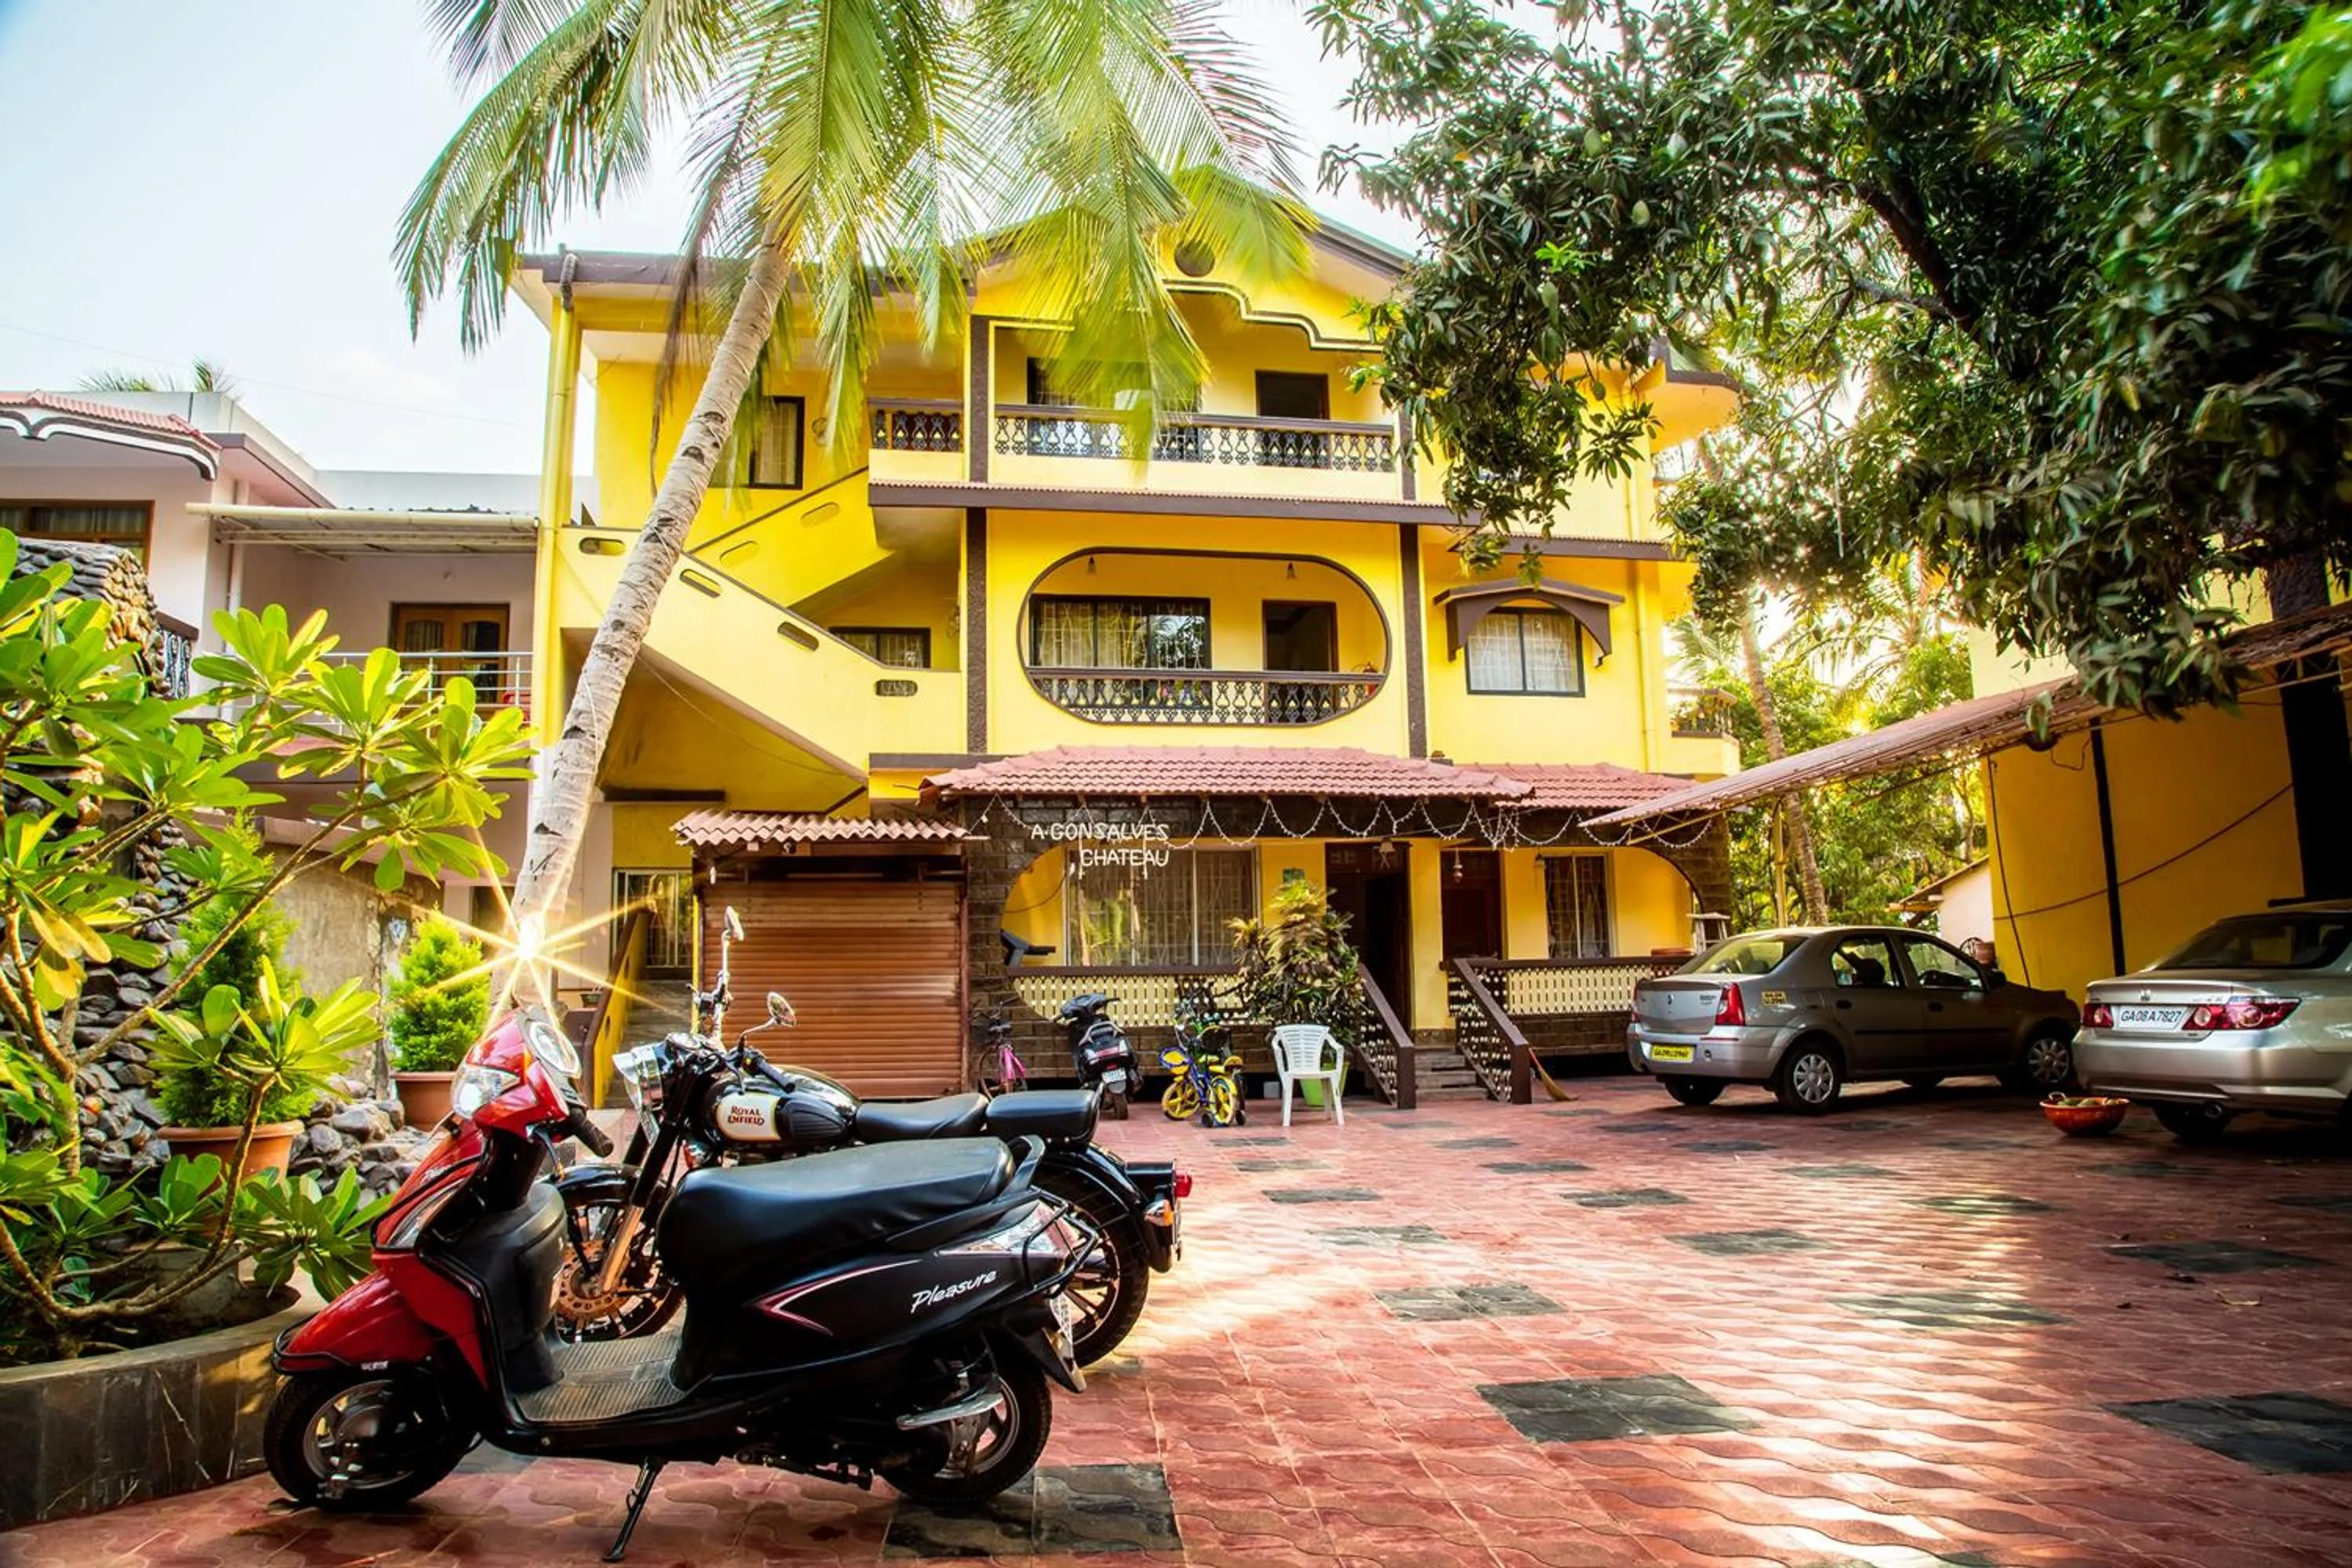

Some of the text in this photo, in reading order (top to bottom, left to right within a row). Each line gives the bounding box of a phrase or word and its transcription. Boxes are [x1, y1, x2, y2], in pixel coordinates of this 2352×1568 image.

[1080, 848, 1170, 866] CHATEAU
[731, 1105, 760, 1116] ROYAL
[728, 1115, 765, 1126] ENFIELD
[910, 1270, 997, 1314] Pleasure
